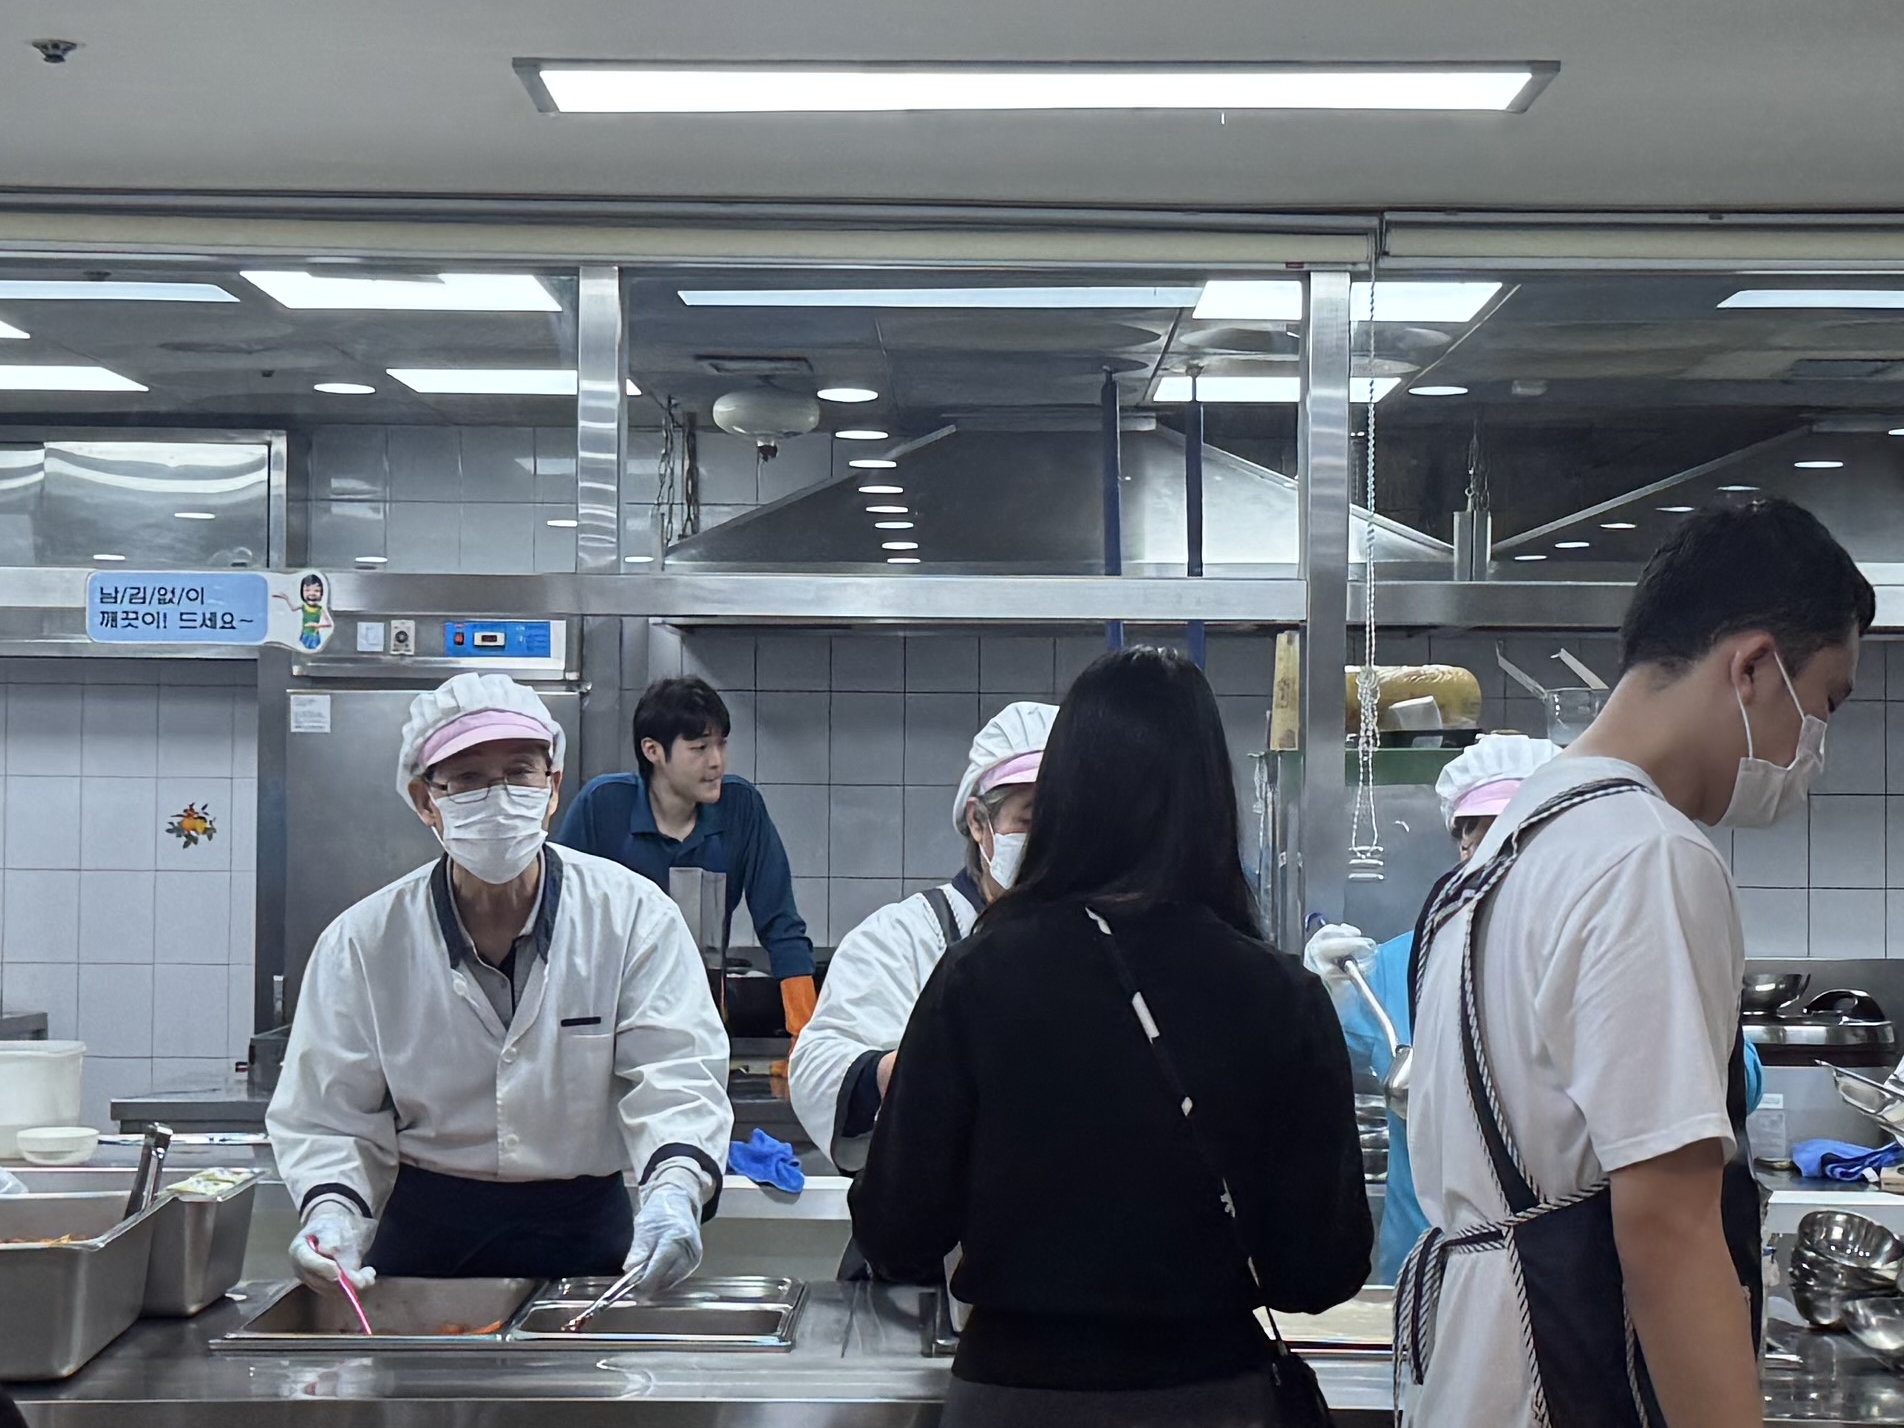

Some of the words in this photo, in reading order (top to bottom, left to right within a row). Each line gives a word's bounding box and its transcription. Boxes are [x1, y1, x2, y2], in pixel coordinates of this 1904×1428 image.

[99, 586, 205, 606] 남/김/없/이
[99, 610, 167, 630] 깨끗이!
[179, 612, 254, 630] 드세요~
